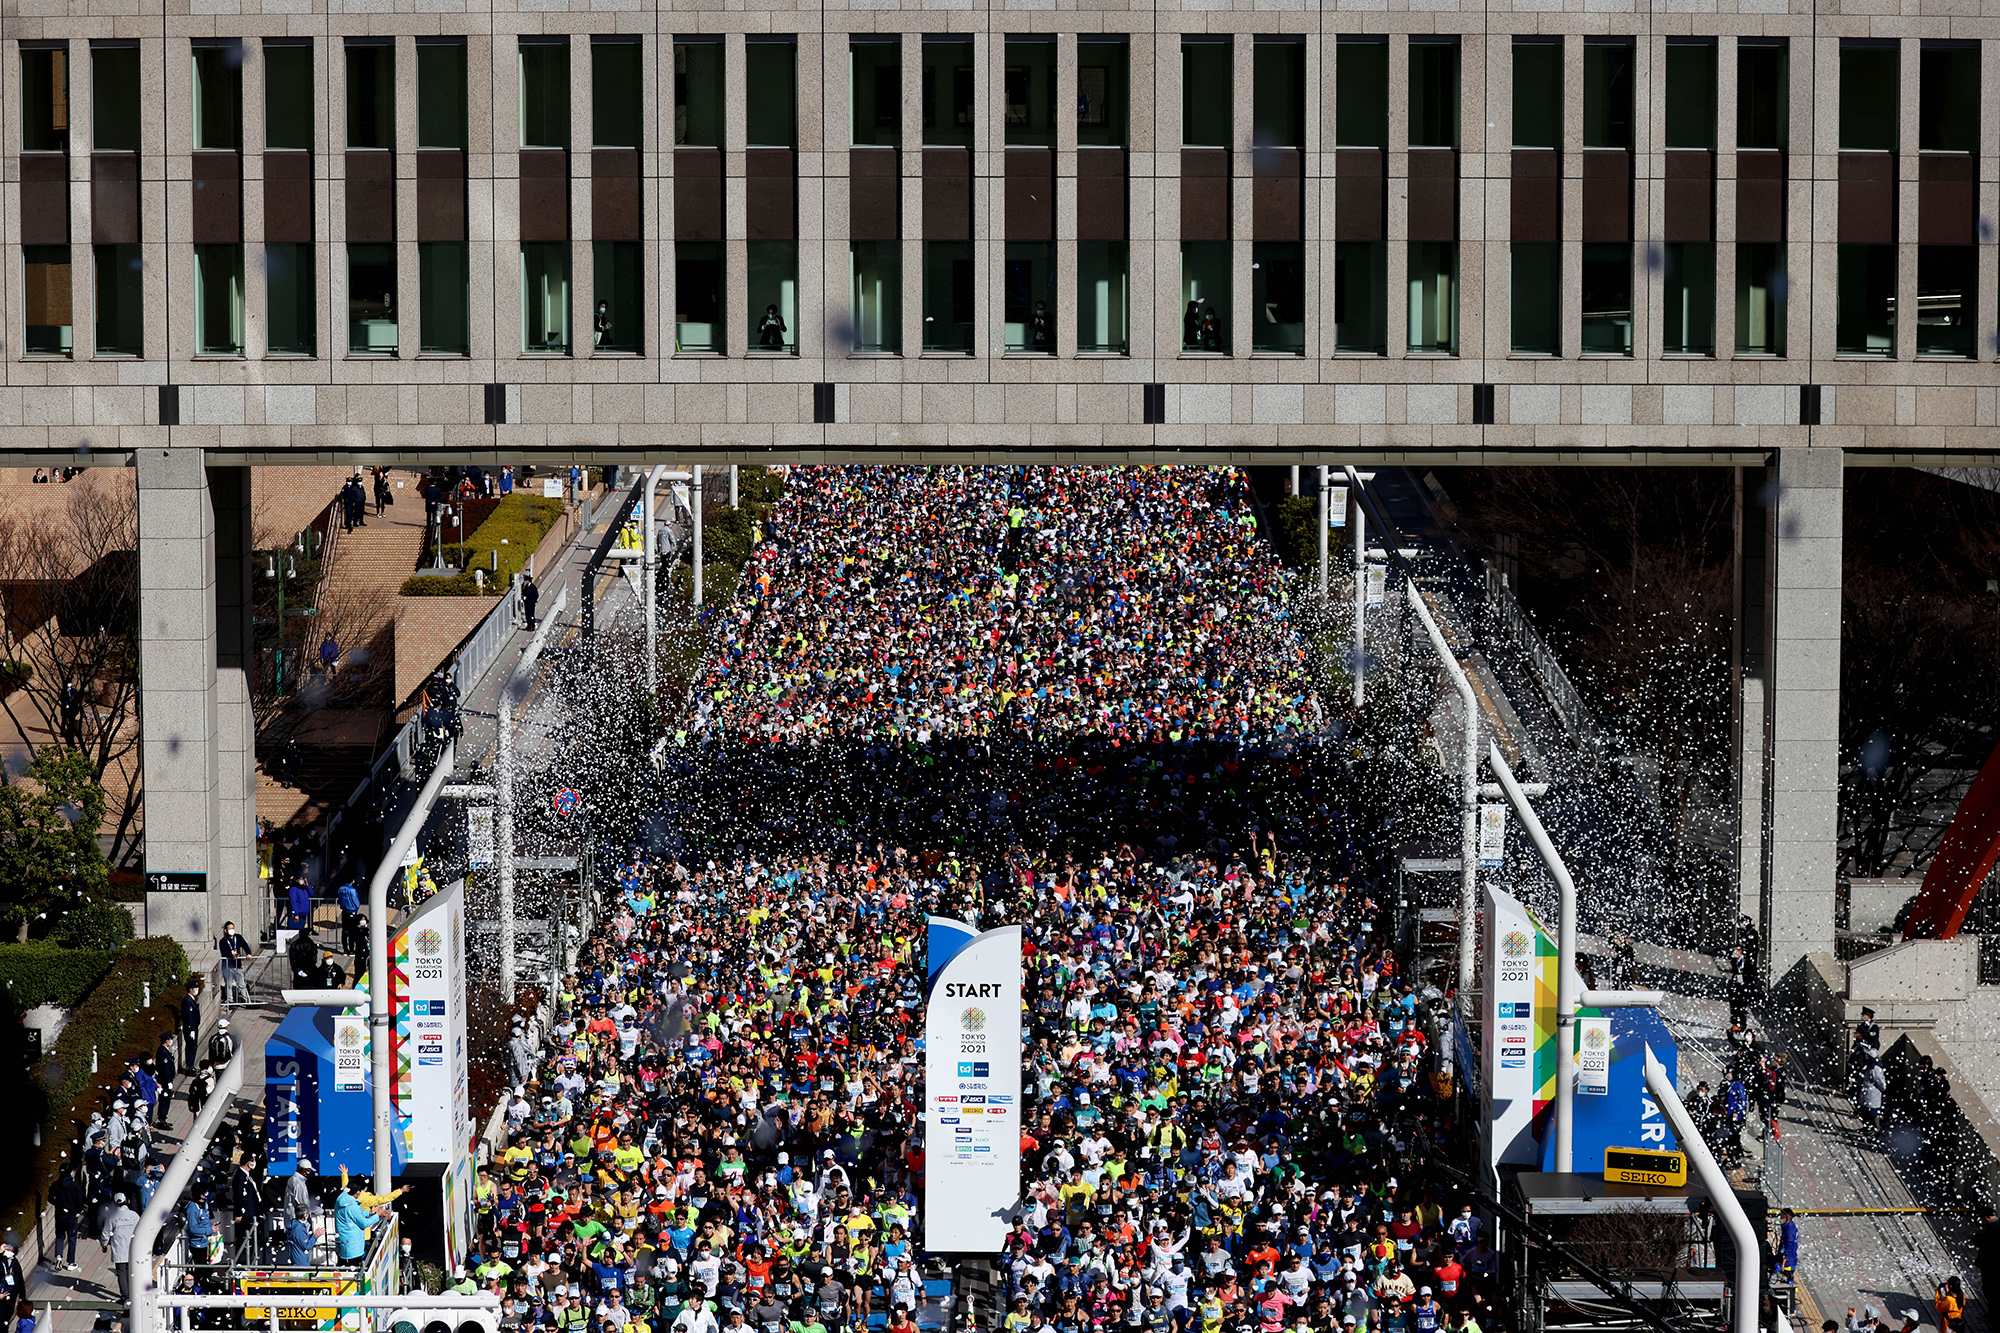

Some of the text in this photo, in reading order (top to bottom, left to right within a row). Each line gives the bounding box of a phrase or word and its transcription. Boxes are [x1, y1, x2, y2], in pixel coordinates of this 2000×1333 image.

[415, 970, 442, 978] 2021
[1502, 972, 1528, 981] 2021
[946, 983, 1001, 997] START
[961, 1045, 985, 1053] 2021
[1583, 1060, 1605, 1068] 2021
[276, 1061, 302, 1158] START
[1620, 1171, 1667, 1184] SEIKO
